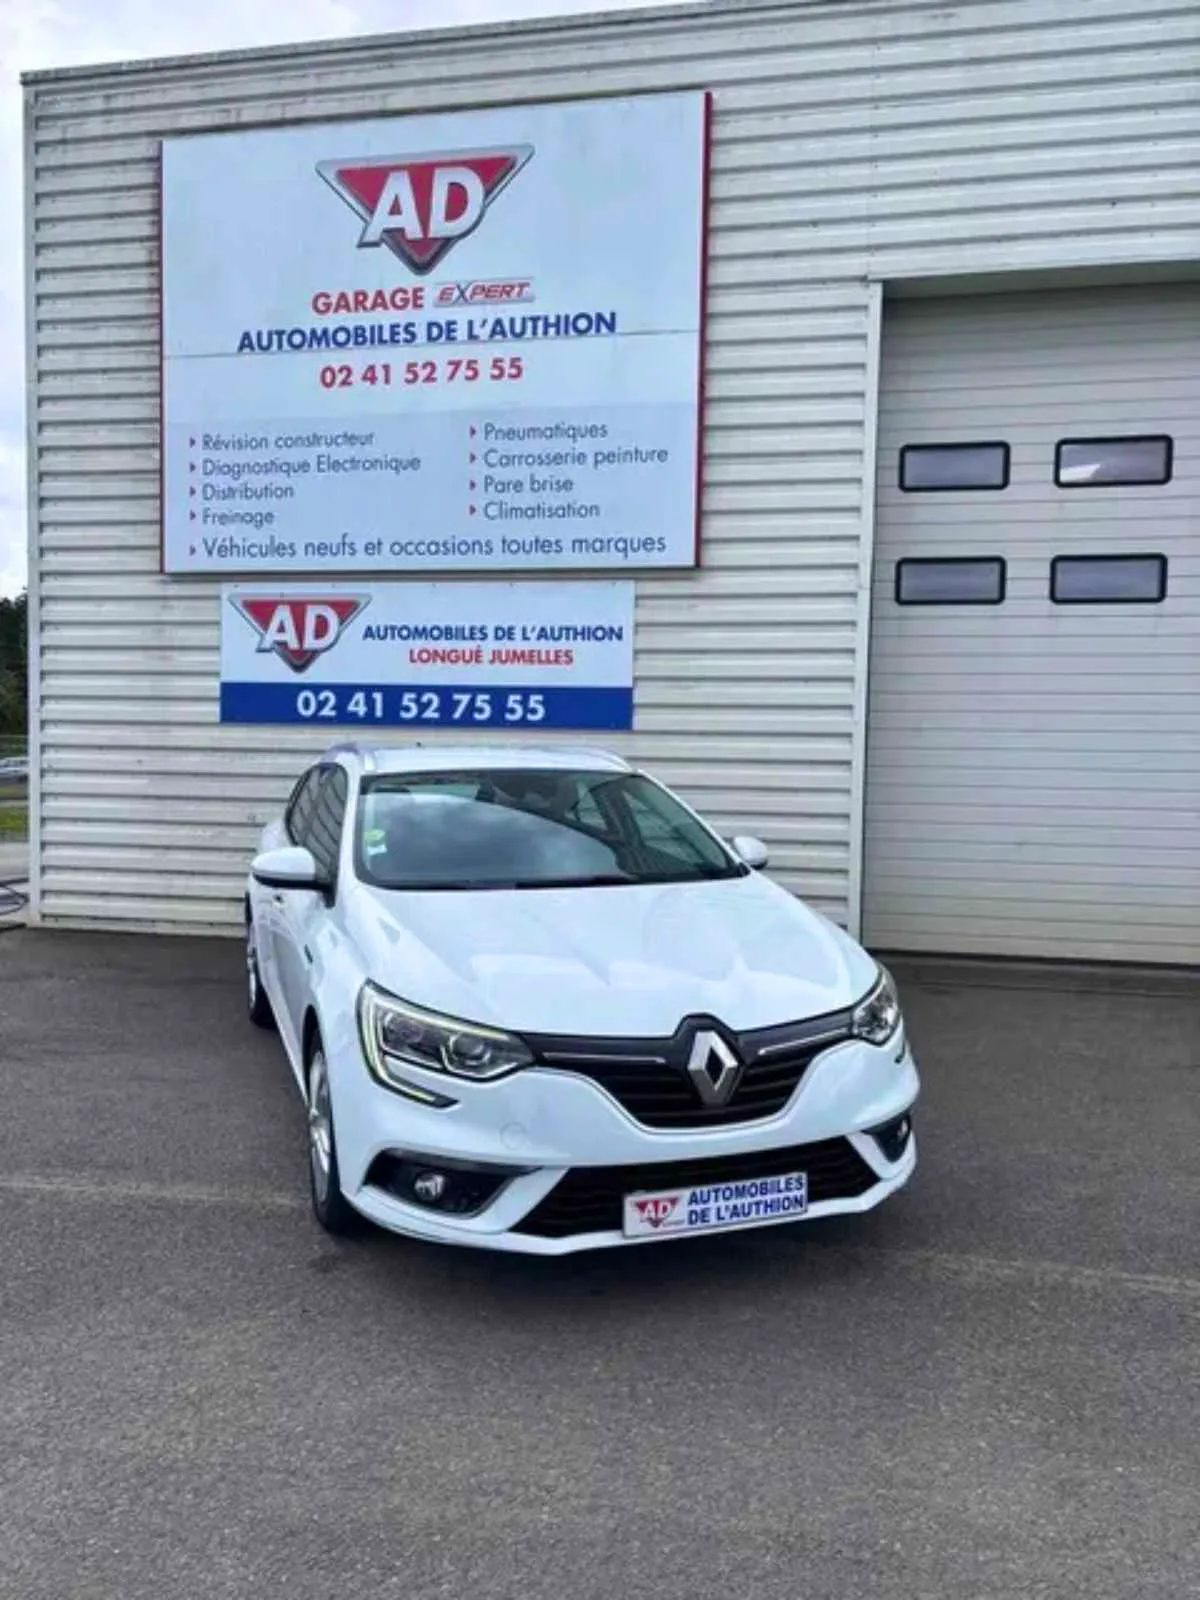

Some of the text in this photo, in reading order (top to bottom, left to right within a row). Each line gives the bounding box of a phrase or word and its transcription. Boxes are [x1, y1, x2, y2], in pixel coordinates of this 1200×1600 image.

[360, 166, 486, 246] AD
[312, 287, 424, 315] GARAGE
[237, 311, 617, 353] AUTOMOBILES DE L'AUTHION
[320, 356, 524, 389] 02 41 52 75 55
[202, 431, 374, 450] Révision constructeur
[484, 421, 608, 443] Pneumatiques
[202, 453, 421, 480] Diagnostique Electronique
[483, 446, 669, 469] Carrosserie peinture
[202, 482, 294, 500] Distribution
[484, 474, 574, 493] Pare brise
[202, 508, 275, 529] Freinage
[483, 500, 600, 520] Climatisation
[202, 532, 666, 558] Véhicules neufs et occasions toutes marques
[258, 603, 340, 652] AD
[362, 625, 623, 642] AUTOMOBILES DE L'AUTHION
[409, 645, 574, 666] LONGUÉ JUMELLES
[296, 690, 545, 721] 02 41 52 75 55
[687, 1175, 804, 1205] AUTOMOBILES
[641, 1202, 672, 1221] AD
[688, 1194, 804, 1225] DE L'AUTHION
